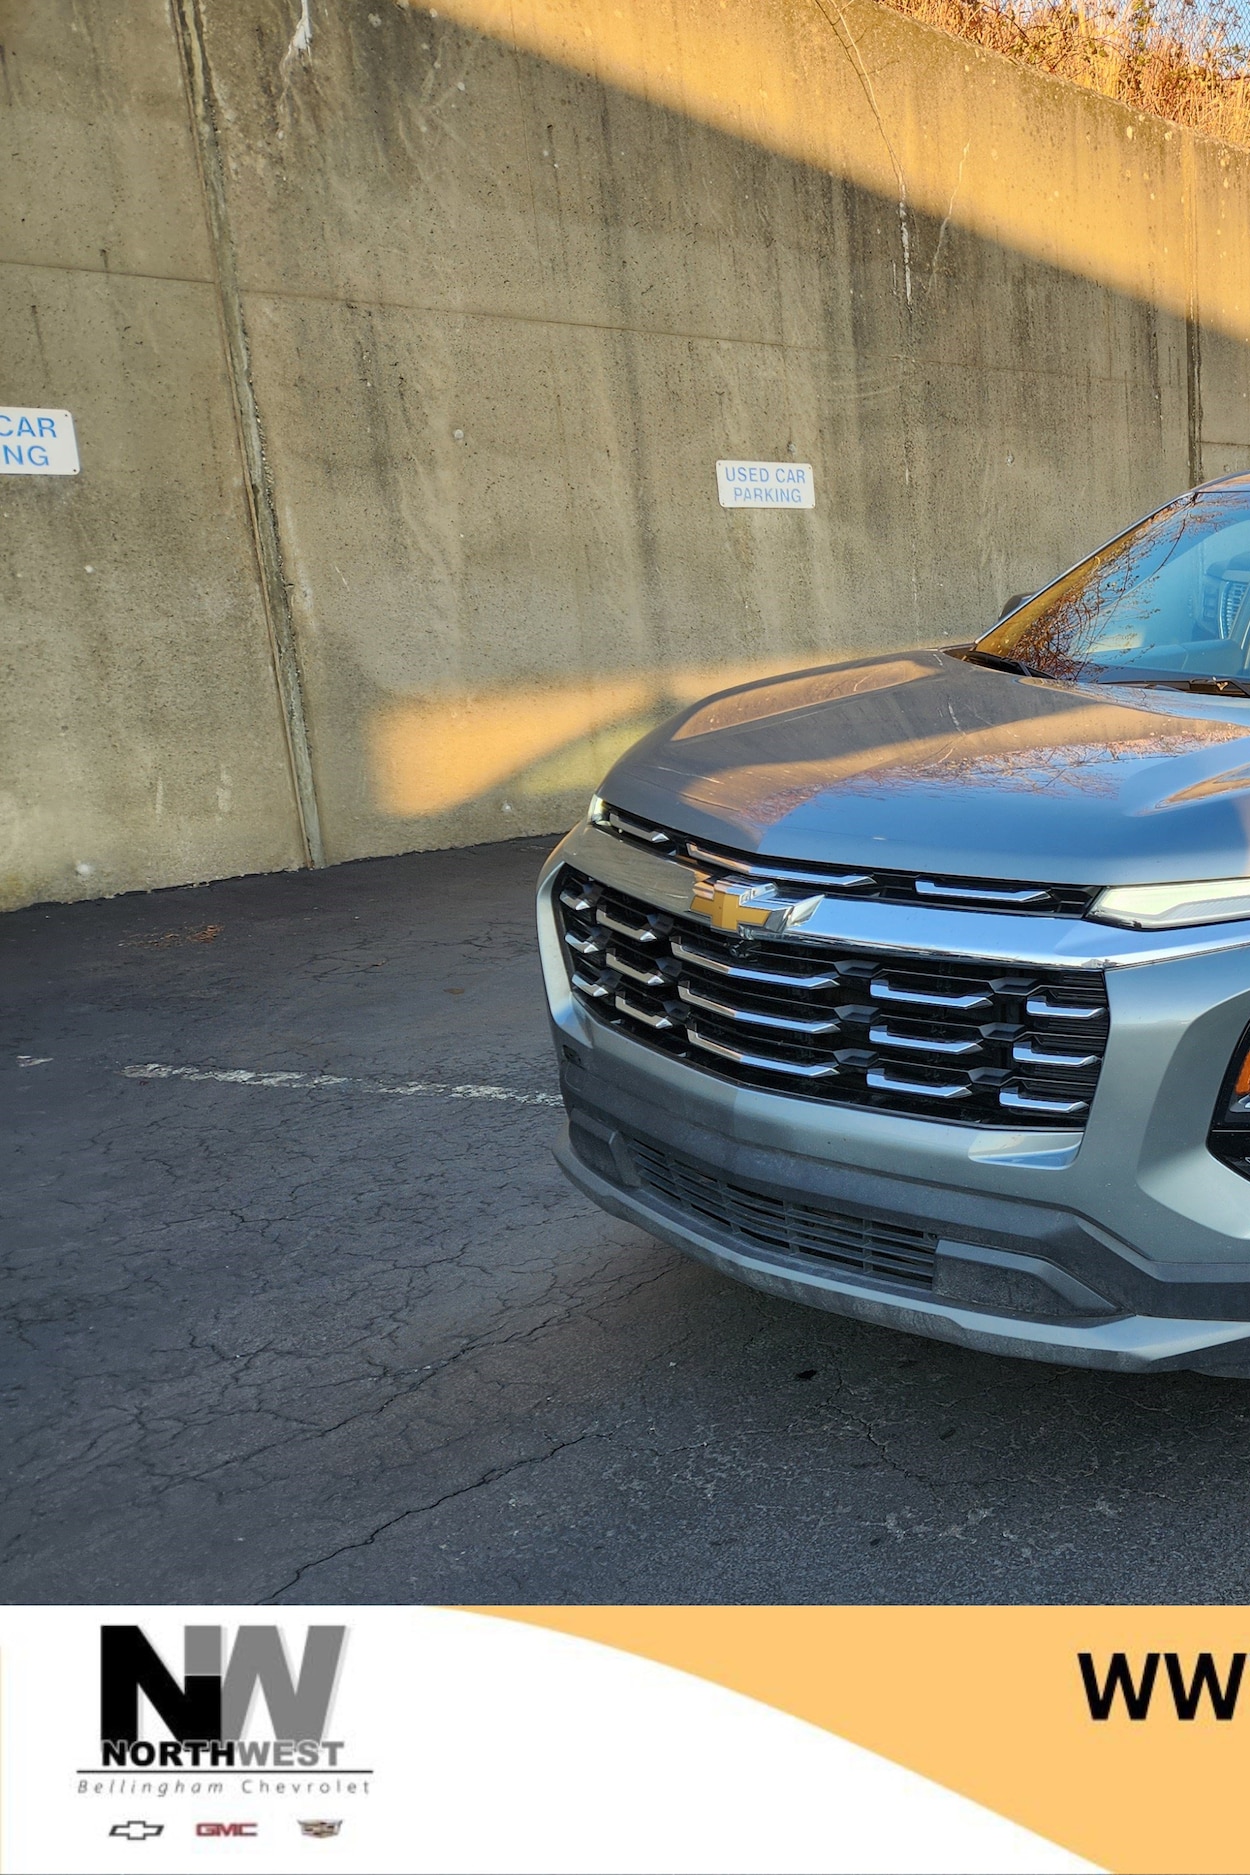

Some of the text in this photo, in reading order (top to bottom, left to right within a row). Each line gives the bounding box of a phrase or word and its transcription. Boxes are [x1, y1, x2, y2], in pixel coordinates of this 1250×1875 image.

[0, 415, 57, 438] CAR
[725, 467, 806, 484] USED CAR
[733, 487, 802, 503] PARKING
